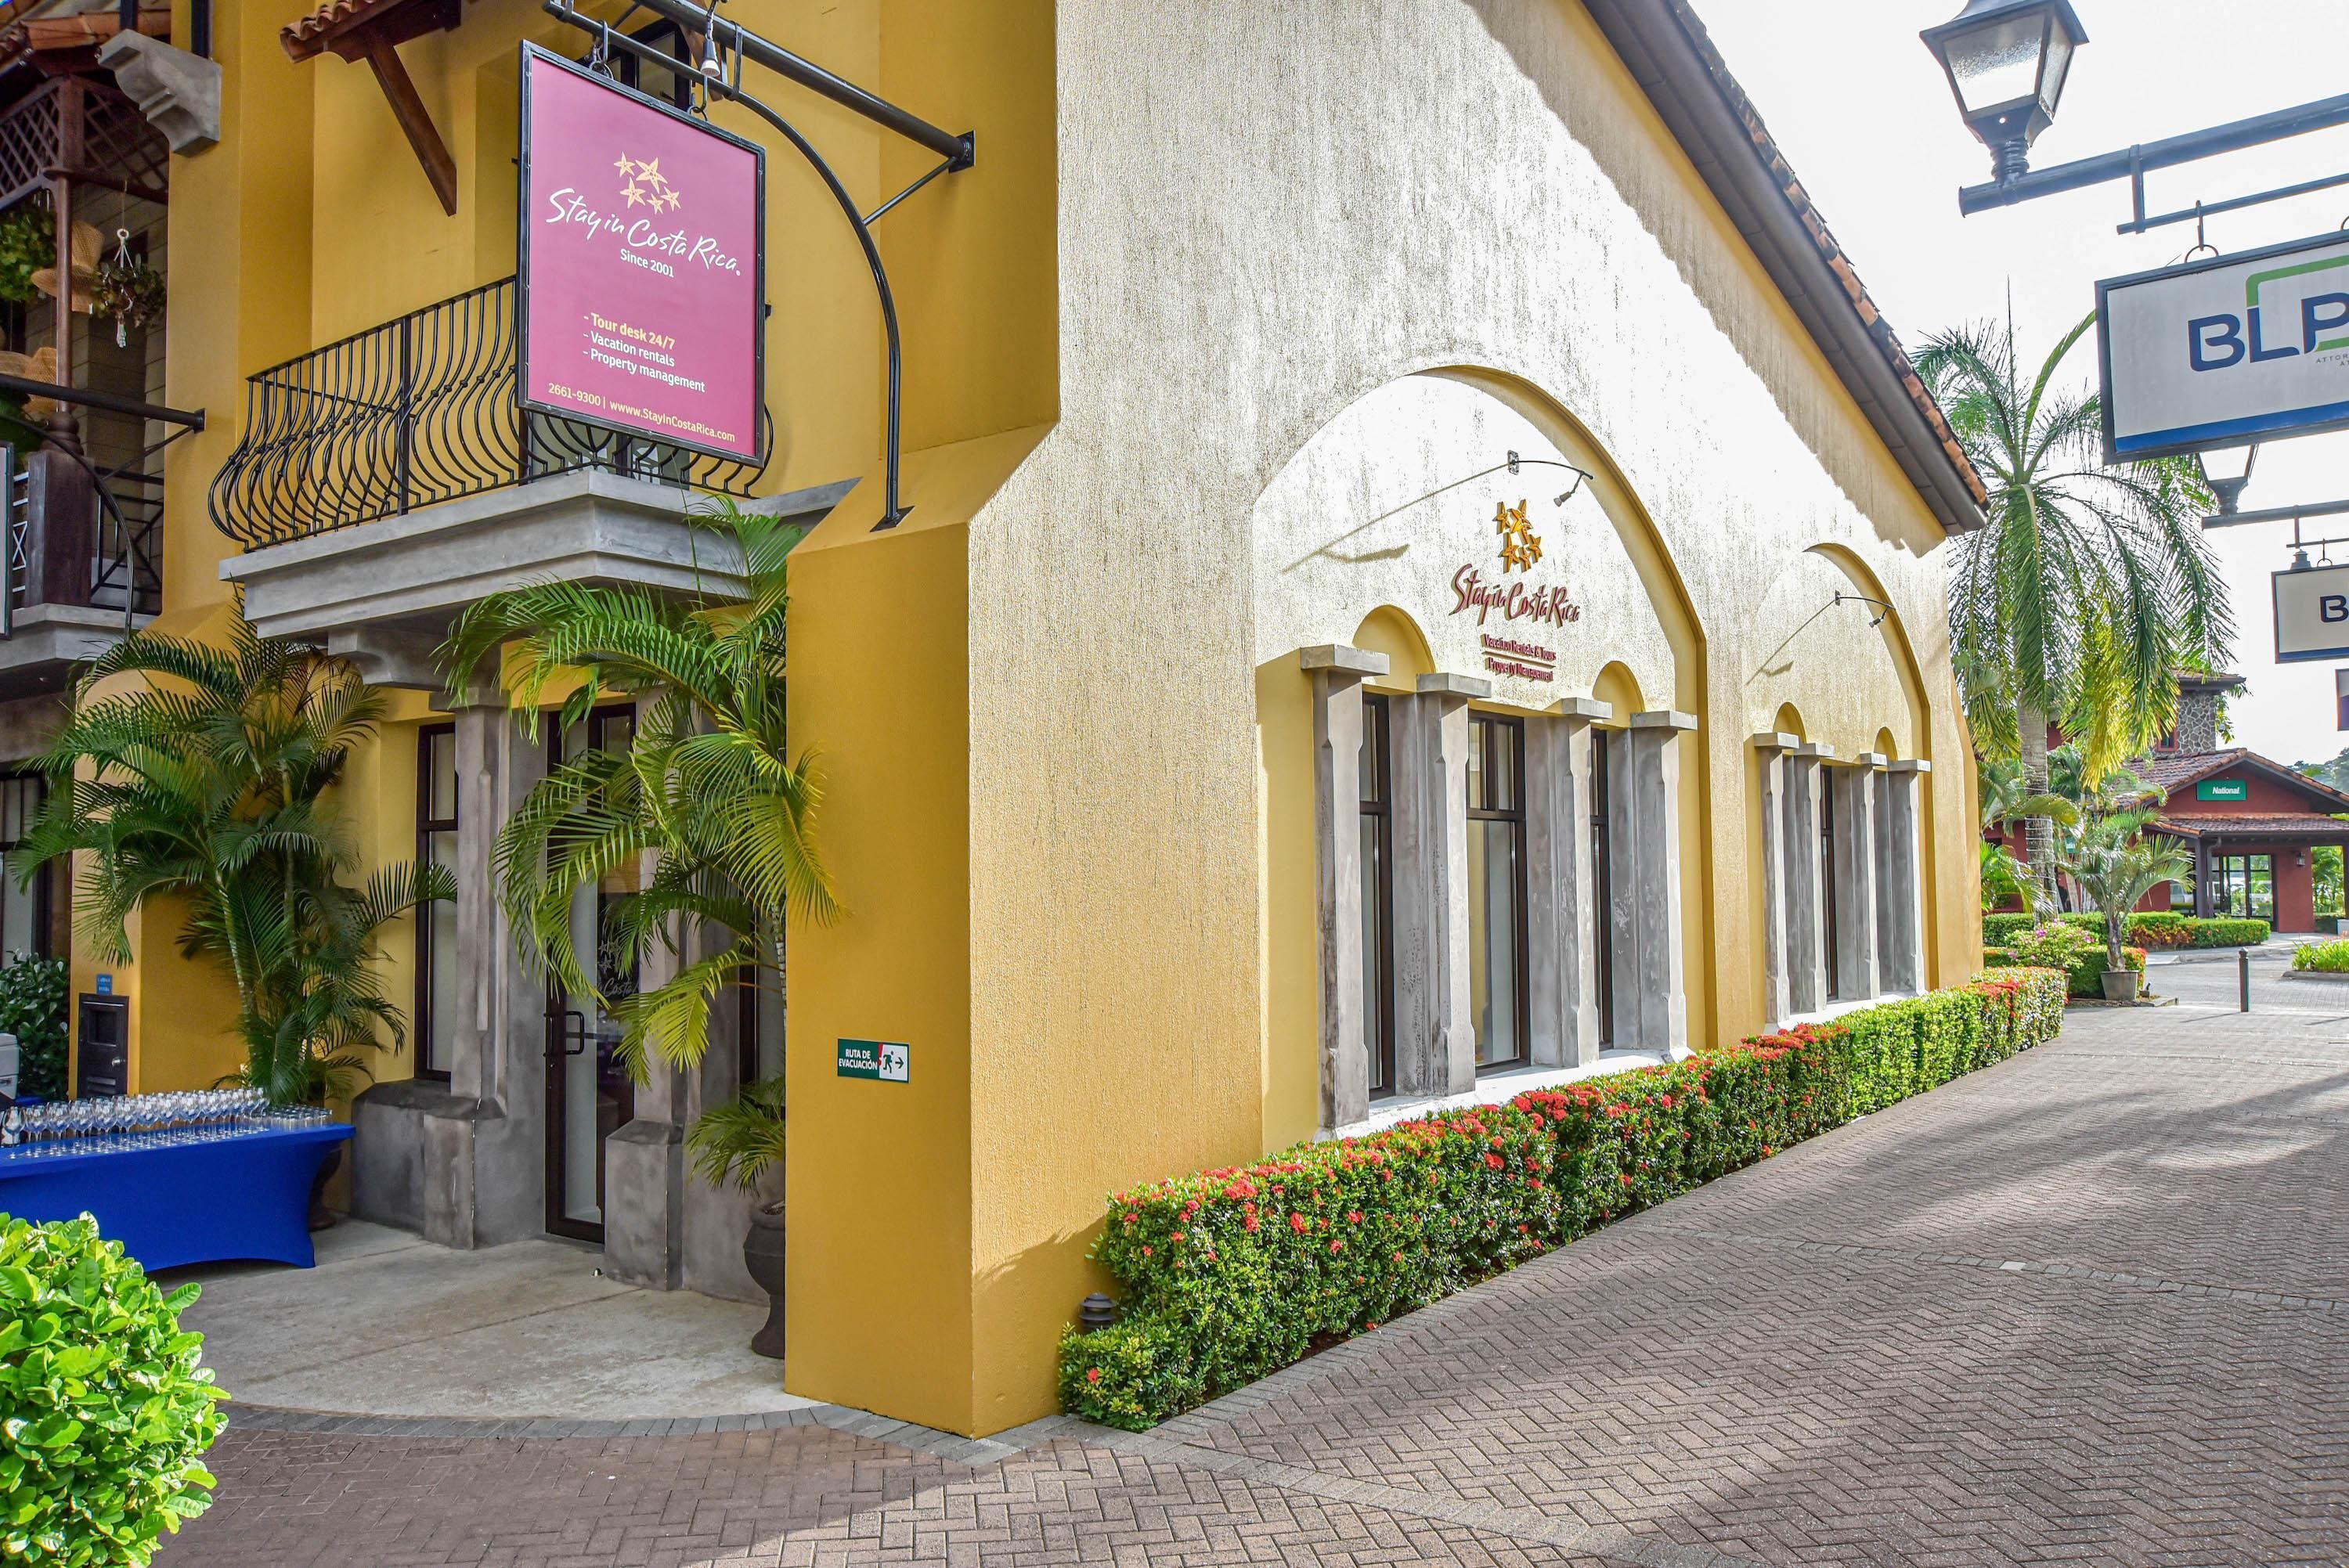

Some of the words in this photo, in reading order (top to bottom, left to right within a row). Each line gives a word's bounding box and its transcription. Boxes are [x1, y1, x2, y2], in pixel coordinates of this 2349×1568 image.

[546, 188, 601, 240] Stay
[604, 214, 624, 233] in
[627, 219, 687, 257] Costa
[620, 248, 648, 269] Since
[650, 259, 674, 278] 2001
[590, 330, 637, 355] Vacation
[638, 347, 675, 367] rentals
[591, 312, 618, 333] Tour
[619, 323, 648, 342] desk
[648, 331, 676, 351] 24/7
[2188, 292, 2349, 372] BLP
[590, 348, 637, 376] Property
[639, 365, 705, 393] management
[548, 383, 601, 407] 2661-9300
[610, 400, 735, 443] wwww.StayInCostaRica.com
[1449, 564, 1488, 626] Stay
[1489, 584, 1506, 609] in
[1504, 582, 1549, 623] Costa
[1545, 586, 1581, 629] Rica
[1481, 633, 1513, 654] Vacation
[1485, 657, 1516, 679] Property
[2212, 786, 2240, 795] National
[839, 1058, 879, 1070] EVACUACIÓN
[845, 1048, 862, 1058] RUTA
[862, 1050, 871, 1060] DE
